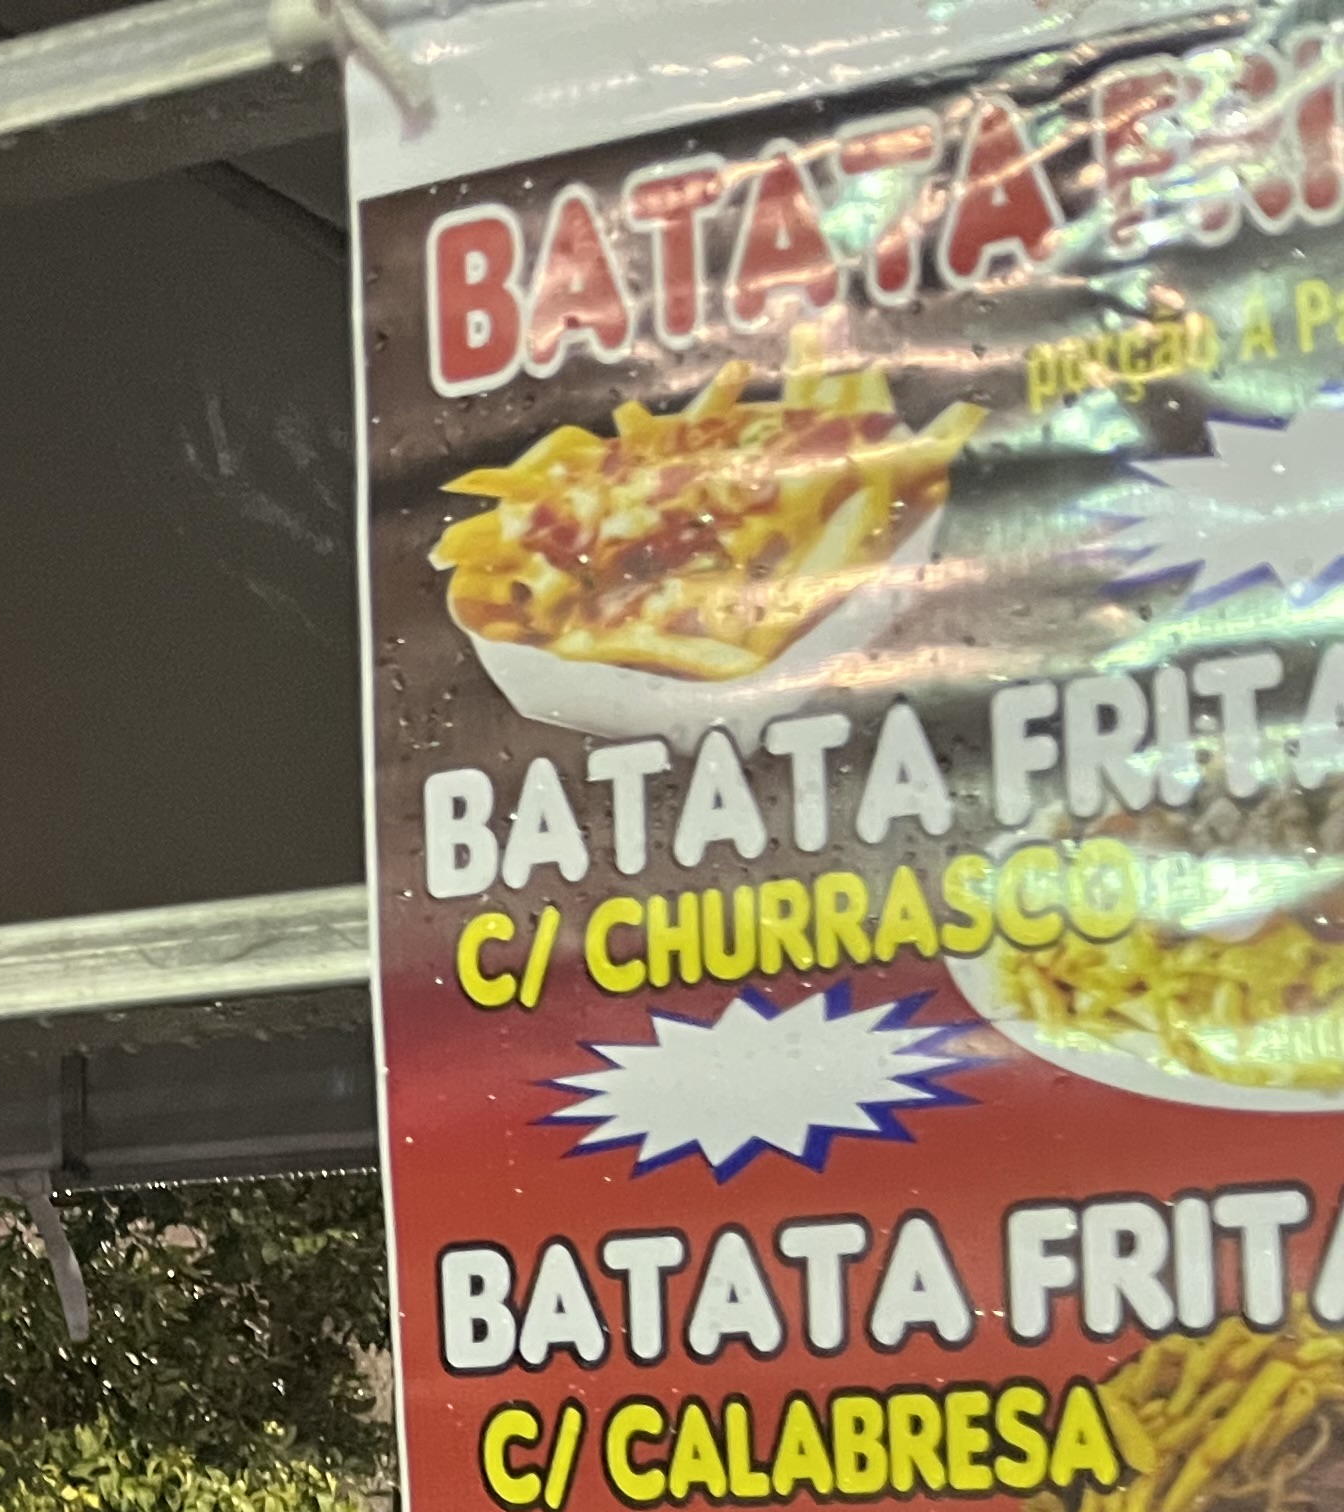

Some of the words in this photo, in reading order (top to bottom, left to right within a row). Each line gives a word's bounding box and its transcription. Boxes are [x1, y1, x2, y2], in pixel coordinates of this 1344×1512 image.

[426, 95, 1066, 397] BATATA
[423, 698, 955, 900] BATATA
[456, 904, 561, 1010] C/
[584, 836, 1145, 995] CHURRASCO
[439, 1211, 976, 1373] BATATA
[603, 1380, 1123, 1506] CALABRESA
